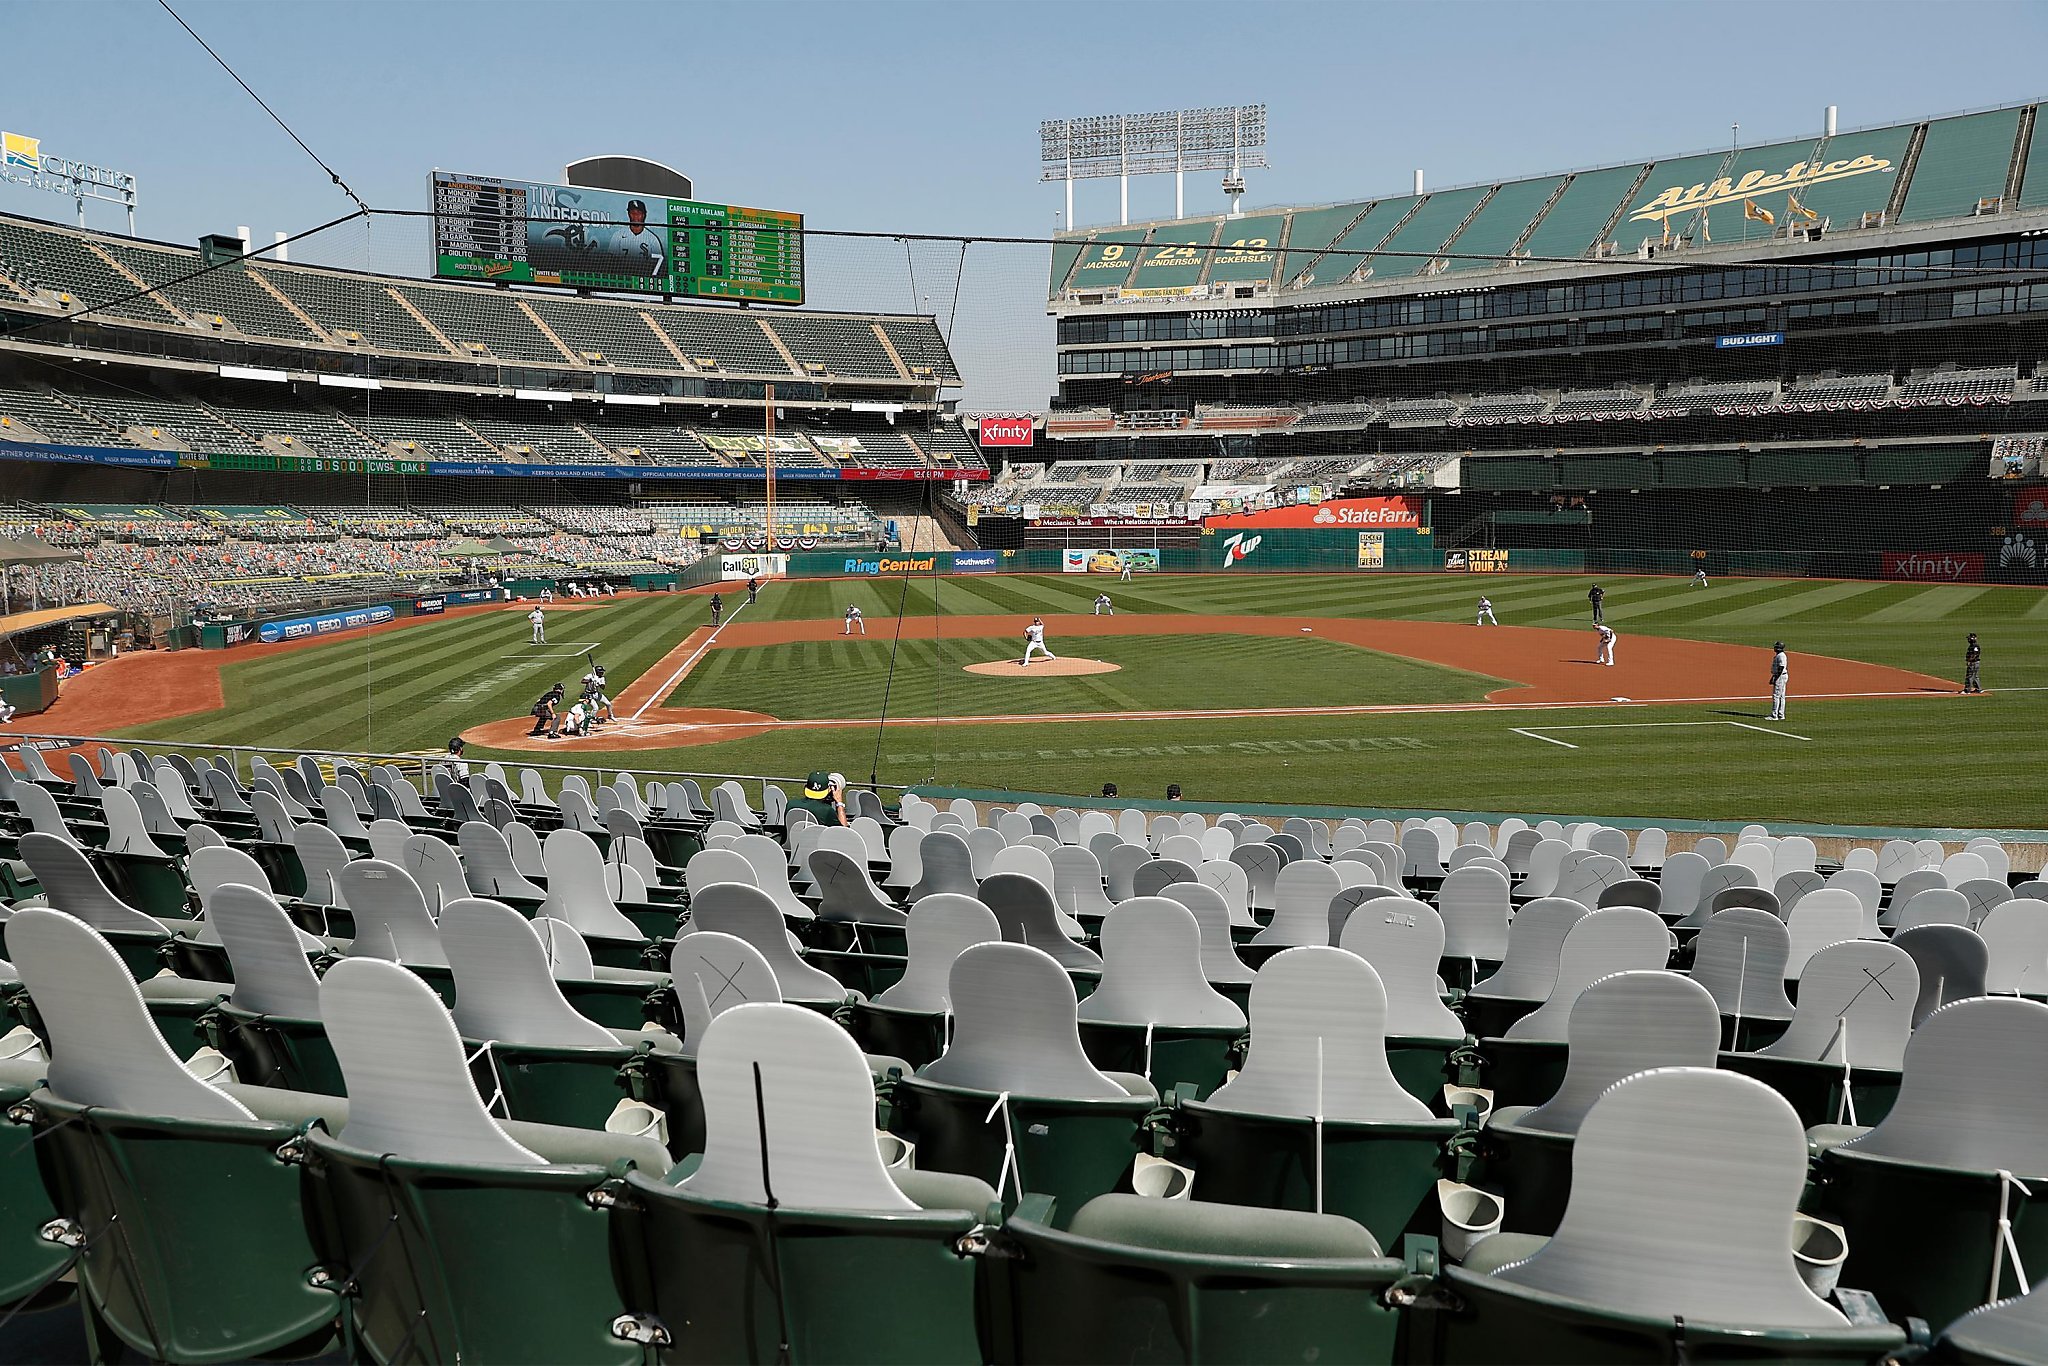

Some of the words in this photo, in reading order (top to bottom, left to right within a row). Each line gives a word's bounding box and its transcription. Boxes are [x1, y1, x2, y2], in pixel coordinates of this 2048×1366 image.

[43, 154, 127, 189] CREEK
[467, 175, 502, 184] CHICAGO
[447, 182, 481, 191] ANDERSON
[1629, 154, 1891, 221] Athletics
[447, 189, 480, 199] MONCADA
[528, 185, 556, 205] TIM
[448, 196, 478, 206] GRANDAL
[669, 204, 691, 213] CAREER
[700, 208, 725, 217] OAKLAND
[530, 205, 611, 229] ANDERSON
[448, 218, 475, 227] ROBERT
[737, 221, 767, 230] GROSSMAN
[449, 226, 470, 234] ENGEL
[449, 233, 474, 242] GARCIA
[449, 241, 482, 251] MADRIGAL
[1154, 241, 1197, 259] 24
[1224, 238, 1268, 256] 43
[448, 249, 473, 258] GIOLITO
[1101, 245, 1124, 261] 9
[1143, 257, 1202, 267] HENDERSON
[1214, 254, 1274, 264] ECKERSLEY
[454, 263, 478, 271] ROOTED
[484, 261, 513, 276] Oakland
[651, 253, 664, 276] 7
[1082, 260, 1131, 270] JACKSON
[738, 267, 761, 275] MURPHY
[738, 275, 763, 283] LUZARDO
[1142, 289, 1162, 297] VISITING
[1173, 288, 1186, 296] ZONE
[1722, 336, 1745, 346] BUD
[1745, 334, 1777, 344] LIGHT
[983, 423, 1030, 441] xfinity
[150, 455, 172, 465] thrive
[179, 452, 197, 461] WHITE
[197, 453, 209, 461] SOX
[315, 459, 323, 471] B
[332, 460, 340, 472] S
[369, 462, 390, 472] CWS
[400, 462, 418, 473] OAK
[475, 466, 495, 476] thrive
[818, 471, 837, 479] thrive
[933, 470, 945, 478] PM
[1338, 507, 1378, 524] State
[1378, 507, 1417, 523] Farm
[1042, 518, 1076, 526] Mechanics
[1077, 518, 1092, 526] Bank
[1124, 518, 1165, 526] Relationships
[719, 526, 743, 535] GOLDEN
[1200, 527, 1215, 536] 362
[1416, 527, 1431, 535] 388
[1002, 549, 1016, 557] 367
[1468, 550, 1509, 561] STREAM
[1690, 550, 1706, 559] 400
[722, 561, 741, 572] Call
[741, 557, 758, 571] 811
[844, 557, 935, 575] RingCentral
[955, 557, 989, 567] Southwest
[1360, 558, 1381, 566] FIELD
[1468, 560, 1494, 572] YOUR
[1495, 560, 1508, 572] A's
[1895, 554, 1967, 580] xfinity
[284, 622, 313, 638] GEICO
[316, 618, 342, 632] GEICO
[345, 613, 369, 628] GEICO
[371, 610, 392, 621] GEICO
[1036, 744, 1224, 760] LIGHT
[1228, 736, 1438, 755] SELTZER
